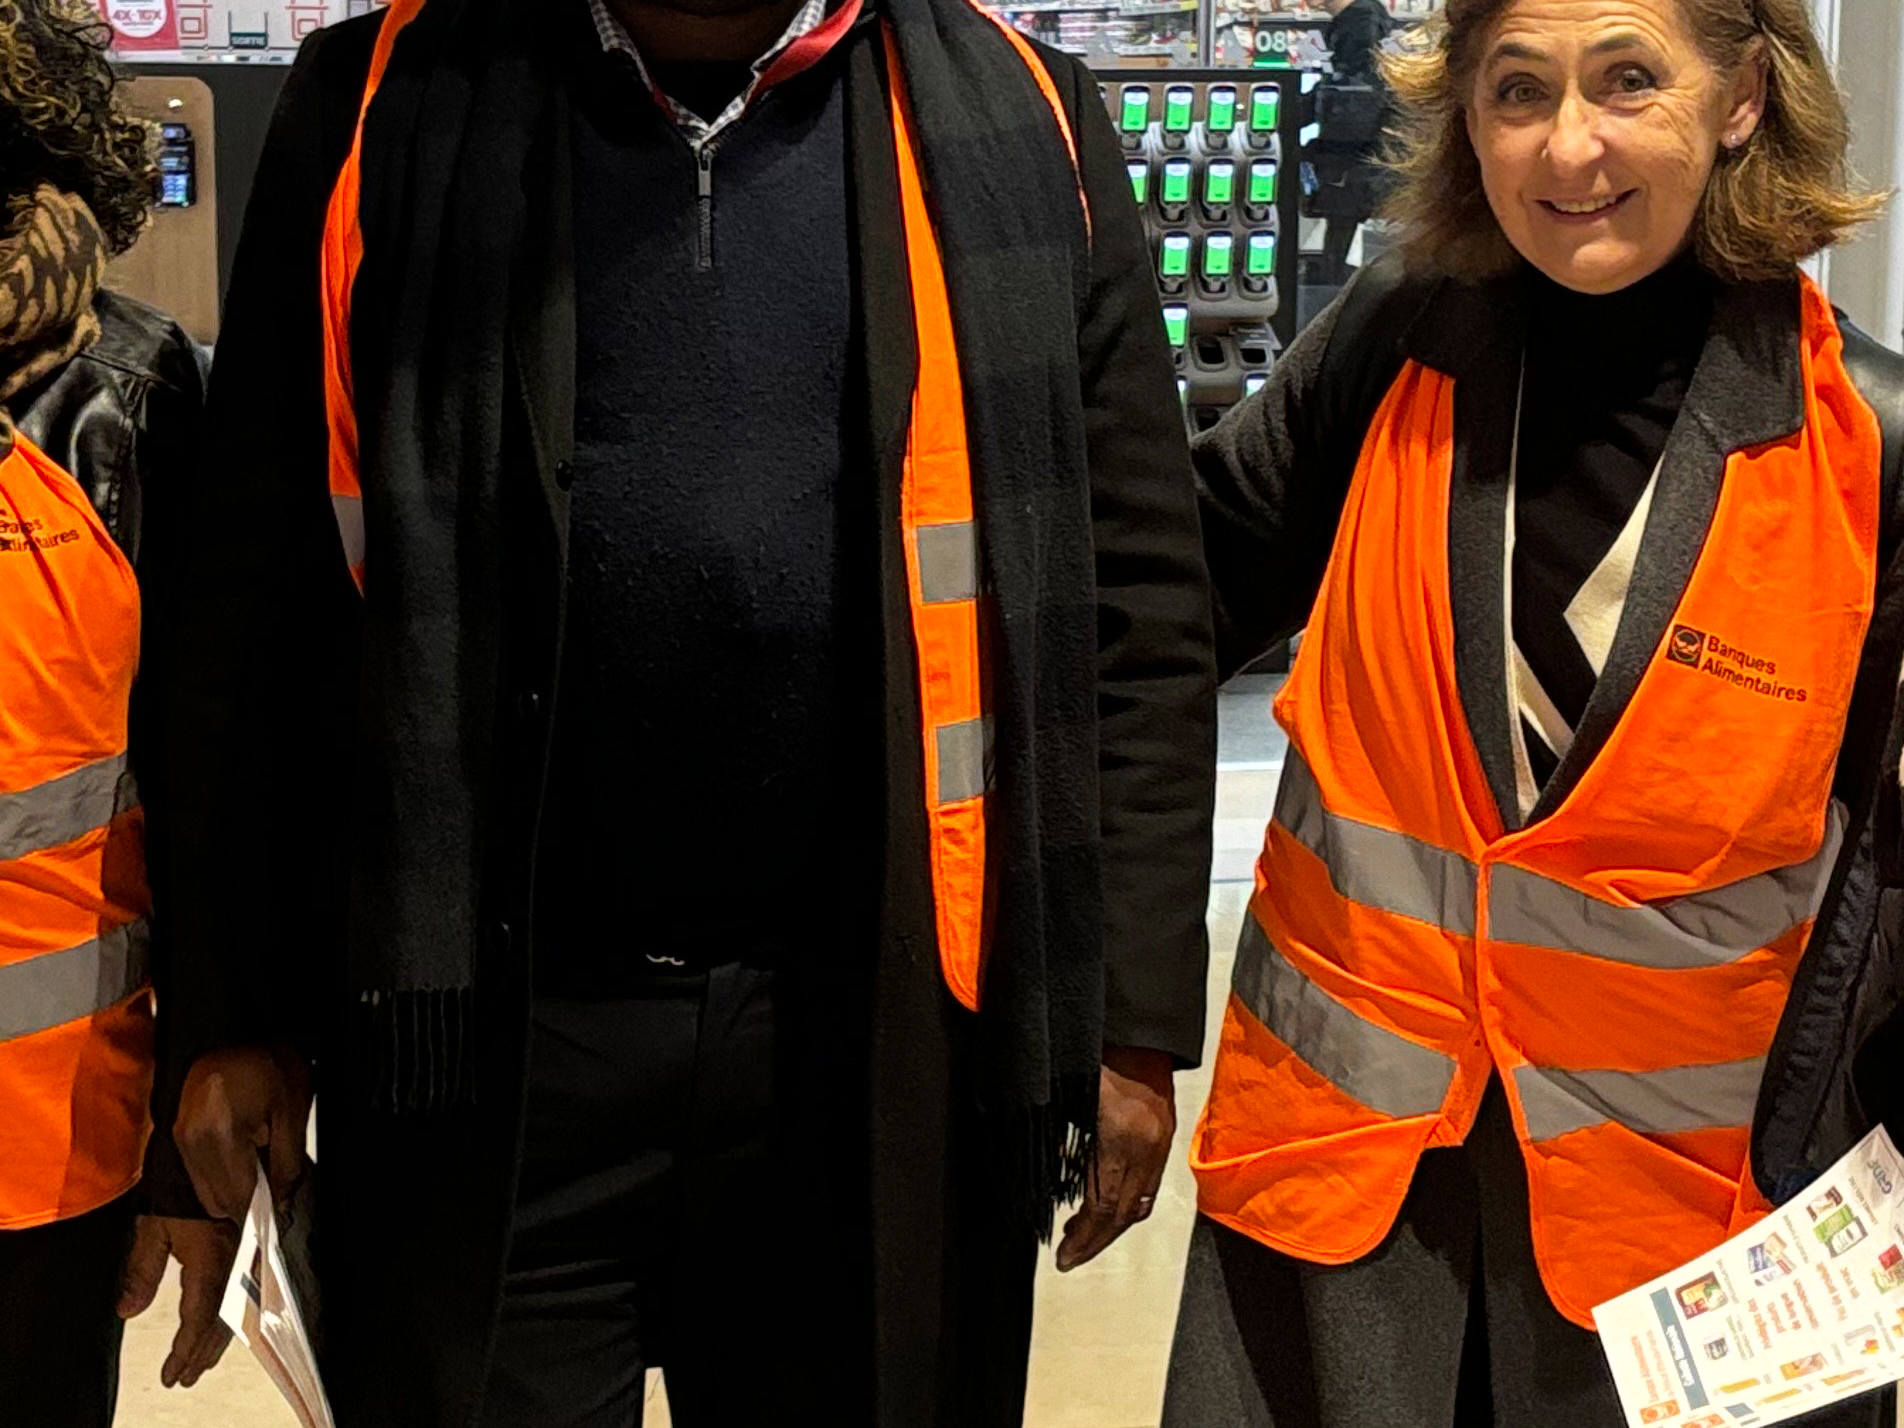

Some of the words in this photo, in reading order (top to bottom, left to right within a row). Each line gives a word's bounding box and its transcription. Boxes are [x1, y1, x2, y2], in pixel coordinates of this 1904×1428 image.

[1255, 29, 1288, 54] 08
[1707, 635, 1777, 676] Banques
[1701, 657, 1808, 702] Alimentaires
